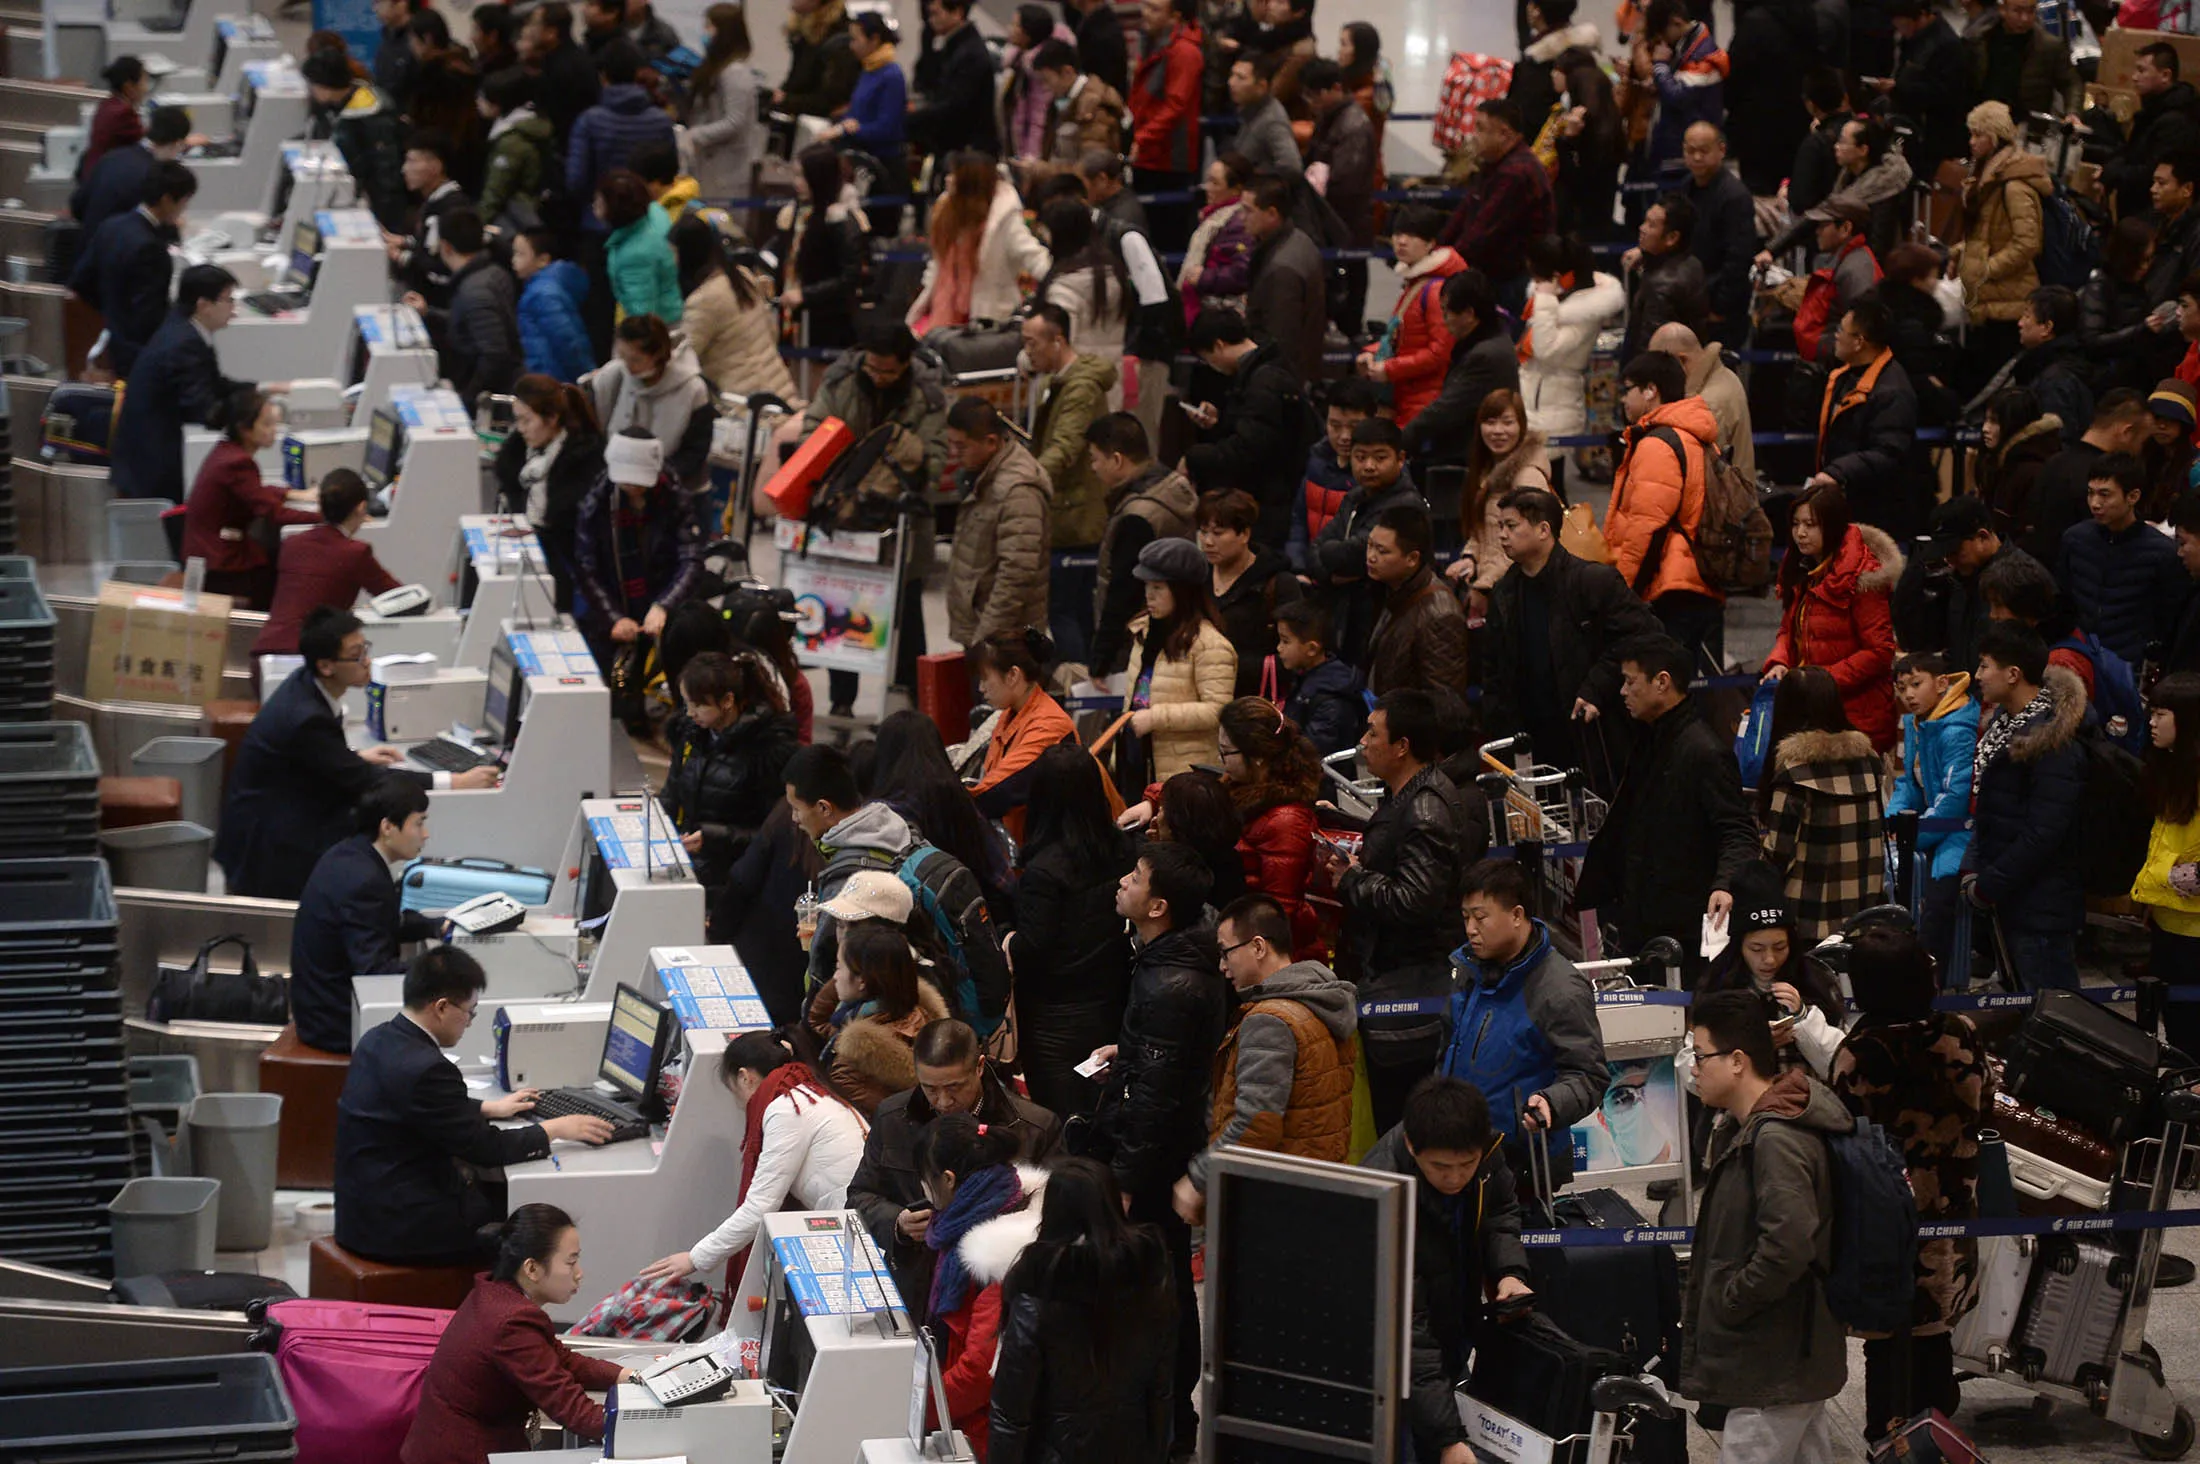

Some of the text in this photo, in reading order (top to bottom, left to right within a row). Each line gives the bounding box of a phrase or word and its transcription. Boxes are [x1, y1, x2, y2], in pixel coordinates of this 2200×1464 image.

[1750, 909, 1783, 921] OBEY
[1603, 993, 1645, 1002] AIR CHINA
[1990, 995, 2033, 1006] AIR CHINA
[1375, 1002, 1419, 1013] AIR CHINA
[2066, 1219, 2114, 1230] AIR CHINA
[1637, 1230, 1686, 1241] AIR CHINA
[1918, 1225, 1966, 1236] AIR CHINA
[1520, 1233, 1561, 1244] IR CHINA
